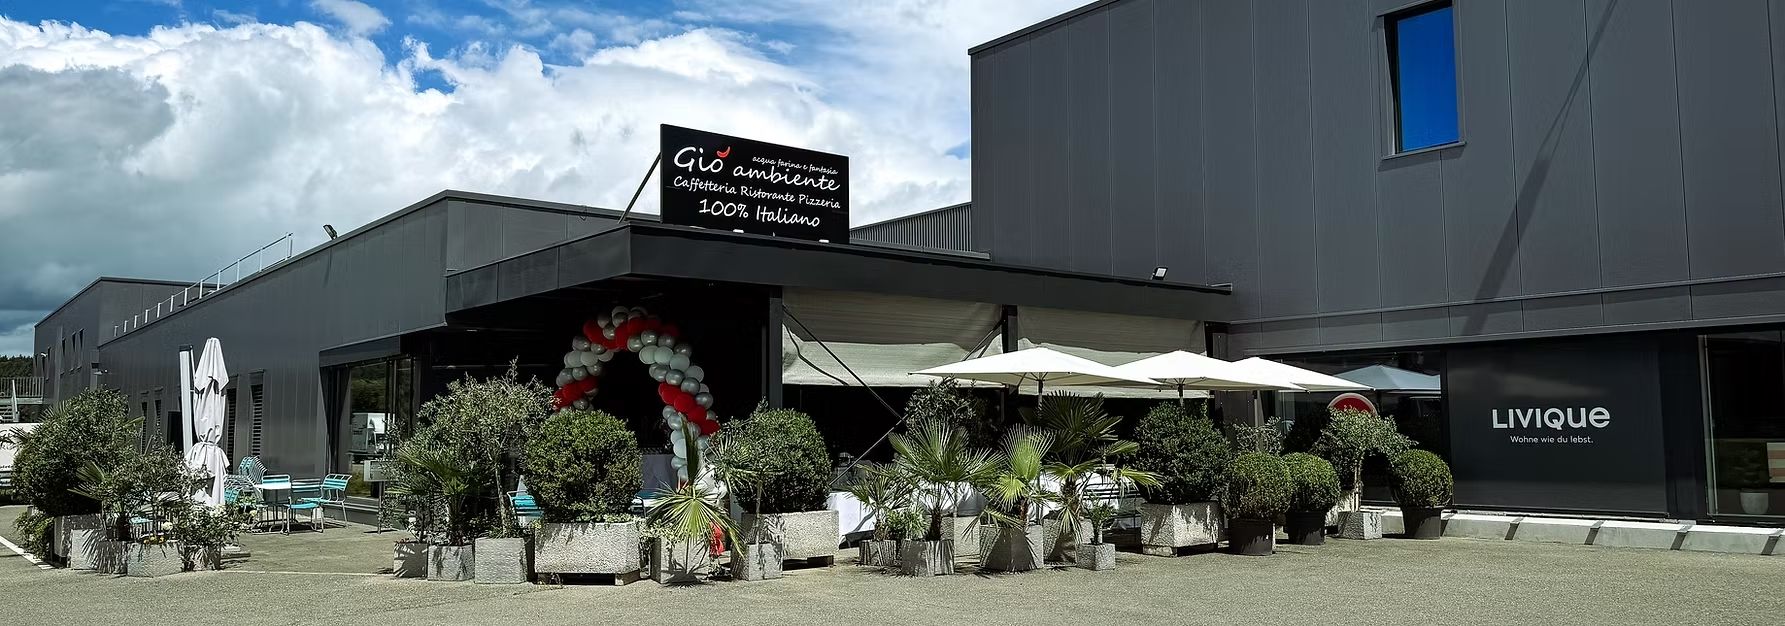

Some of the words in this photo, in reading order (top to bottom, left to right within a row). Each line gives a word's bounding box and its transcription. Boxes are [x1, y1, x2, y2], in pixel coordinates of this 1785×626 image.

[733, 165, 840, 191] ambiente
[752, 156, 777, 165] acqua
[777, 159, 802, 169] farina
[808, 164, 838, 175] fantasia
[673, 176, 737, 194] Caffetteria
[740, 186, 796, 203] Ristorante
[798, 194, 841, 209] Pizzeria
[699, 199, 749, 218] 100%
[756, 206, 820, 227] Italiano
